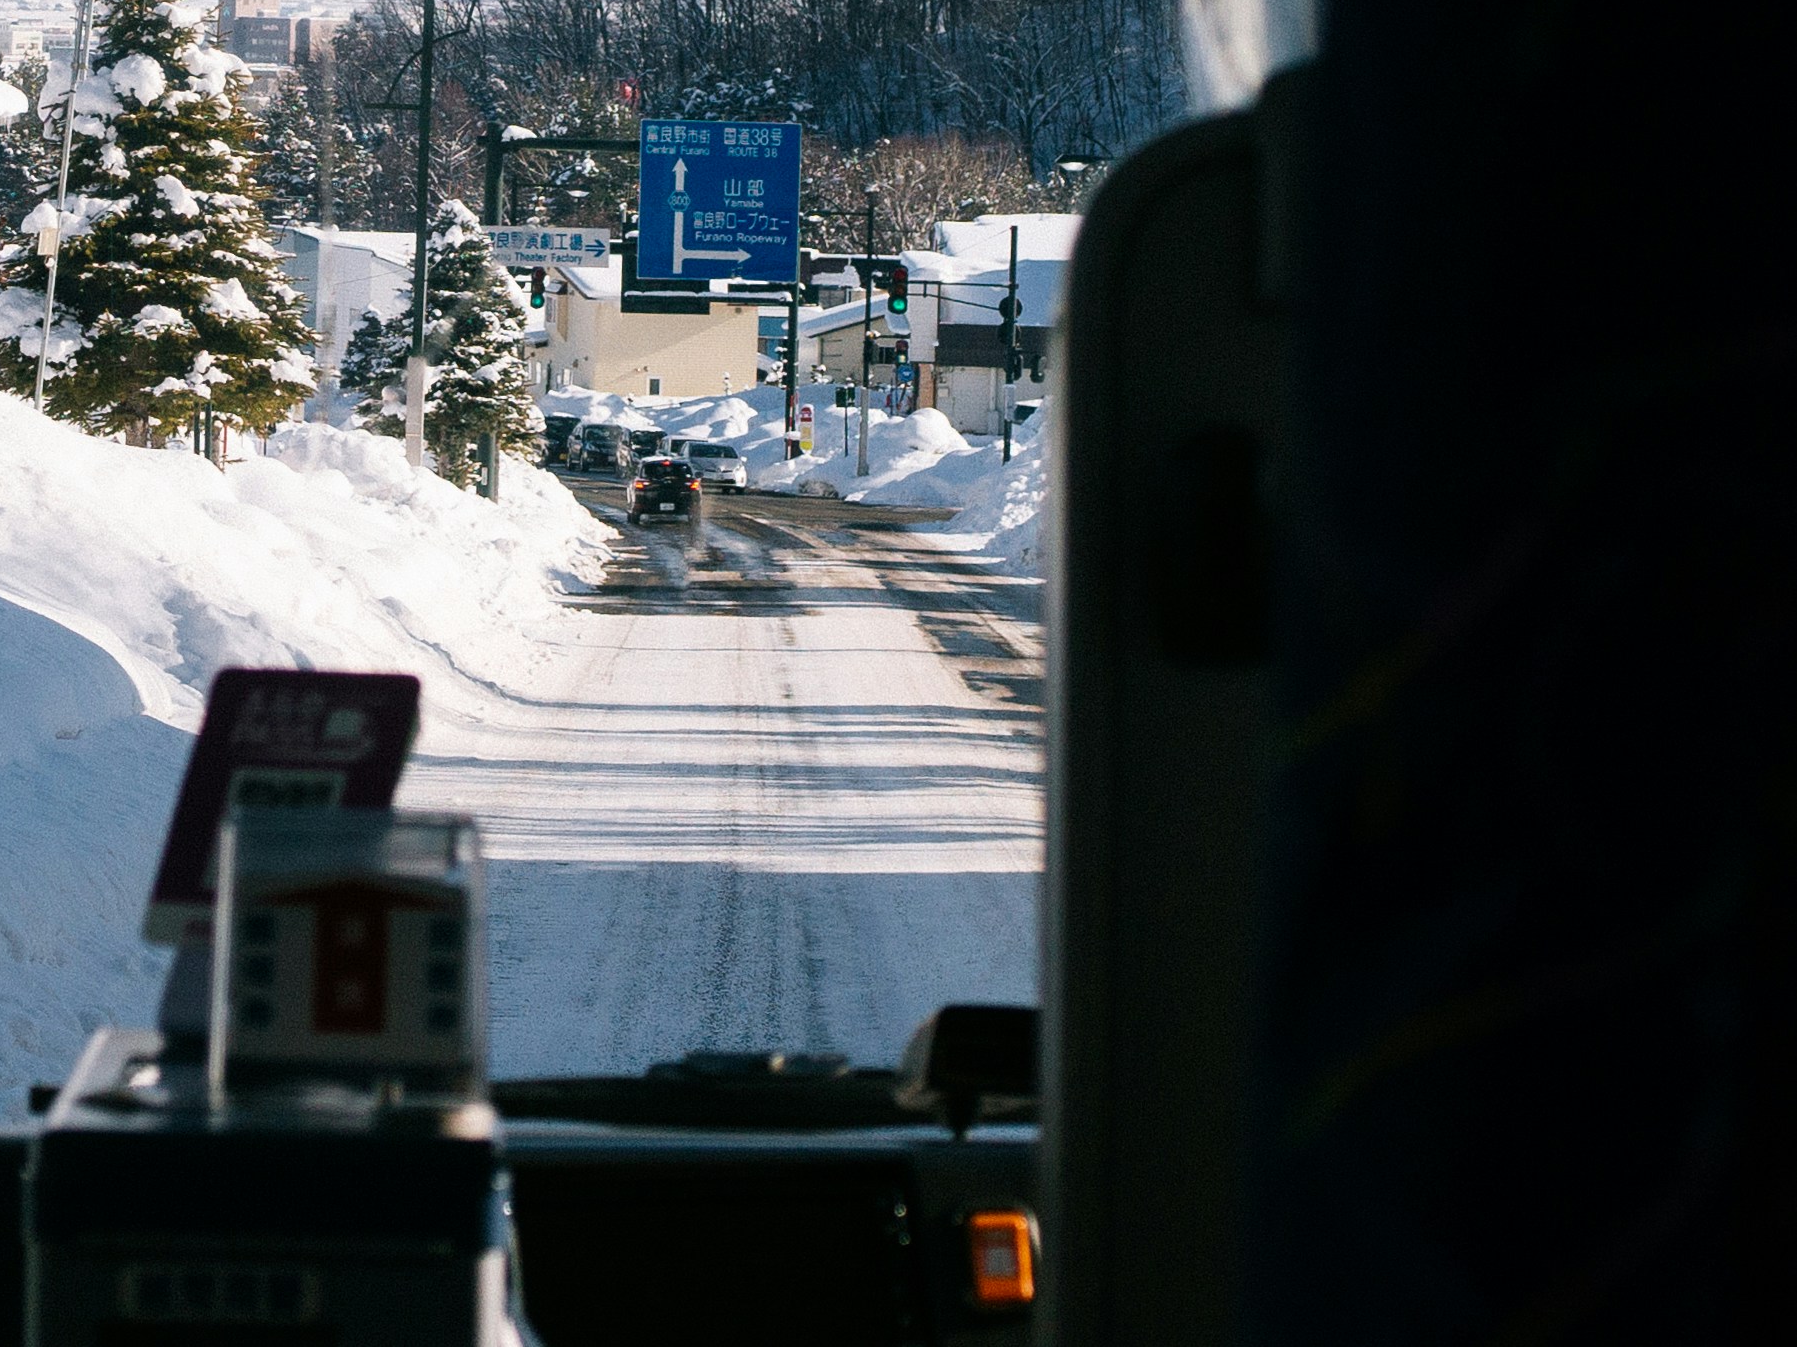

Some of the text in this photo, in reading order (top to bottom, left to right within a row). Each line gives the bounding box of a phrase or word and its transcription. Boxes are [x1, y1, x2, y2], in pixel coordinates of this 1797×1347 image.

[646, 125, 711, 144] 富良野市街
[724, 127, 783, 146] 国道38号
[645, 145, 711, 156] Central Furano
[727, 147, 779, 158] ROUTE 38
[723, 197, 764, 208] Yamabe
[693, 210, 790, 231] 富良野ロープウェー
[695, 231, 788, 246] Furano Ropeway
[515, 252, 547, 262] Theater
[550, 253, 583, 264] Factory
